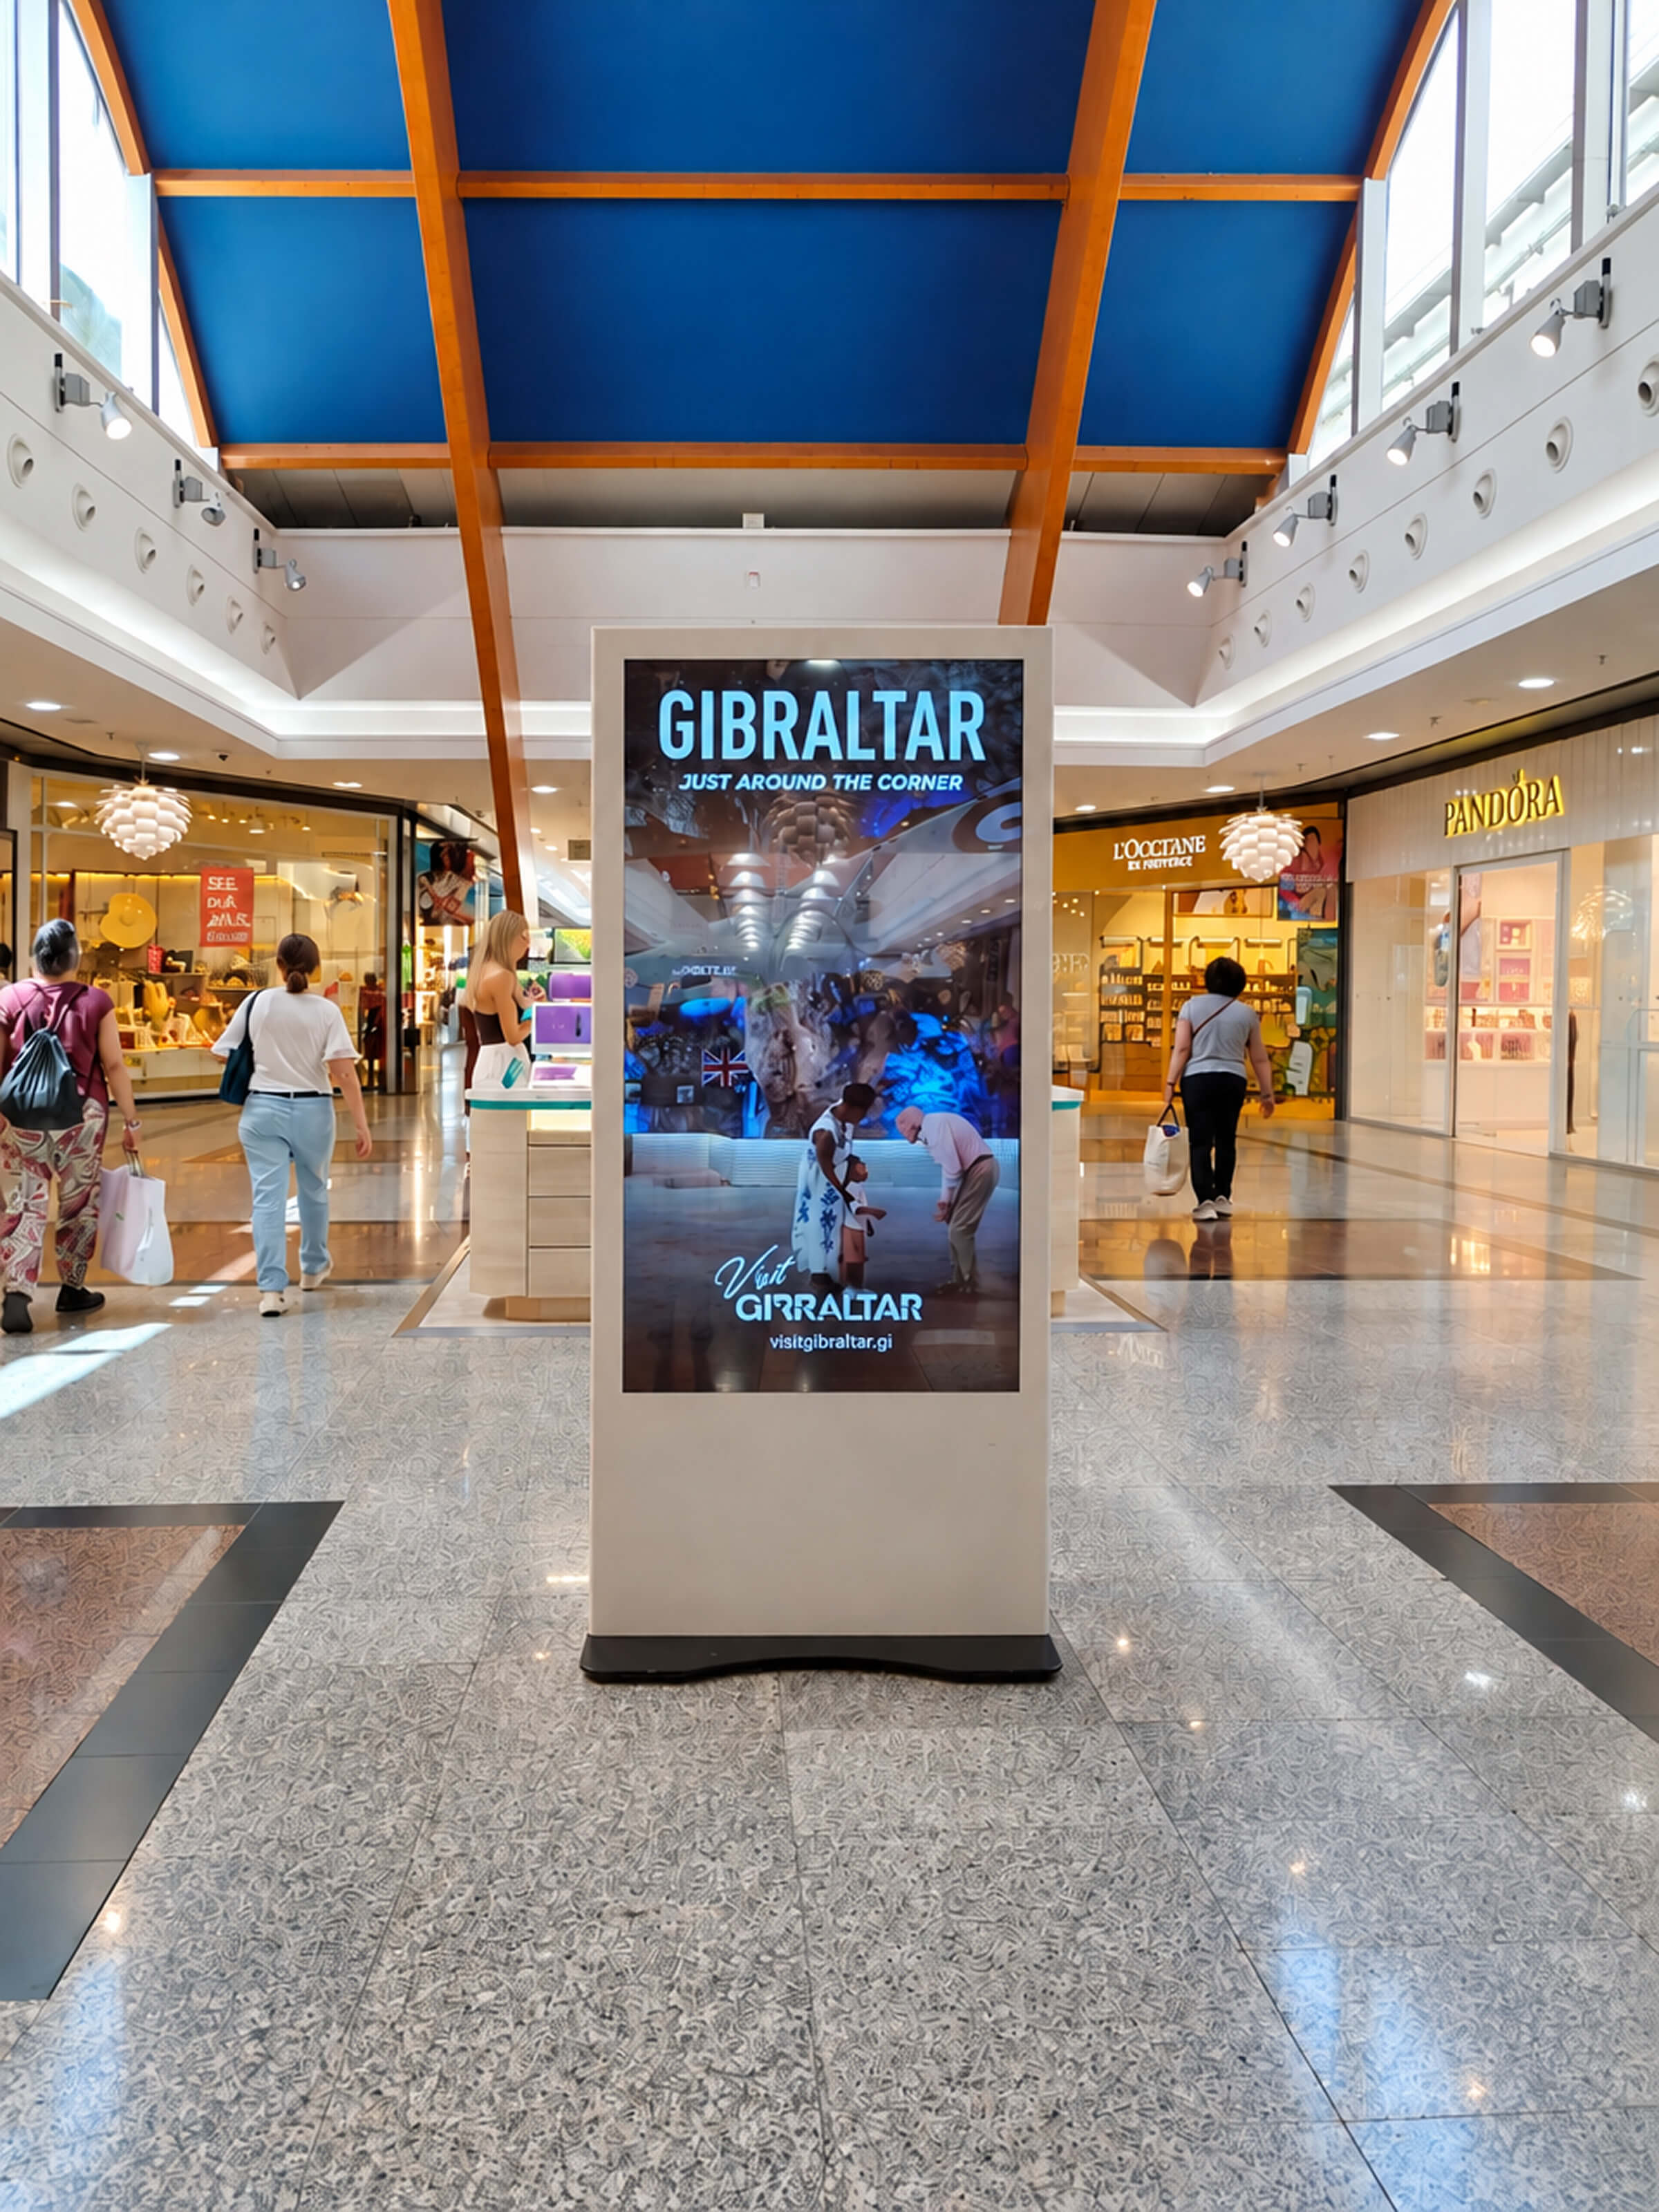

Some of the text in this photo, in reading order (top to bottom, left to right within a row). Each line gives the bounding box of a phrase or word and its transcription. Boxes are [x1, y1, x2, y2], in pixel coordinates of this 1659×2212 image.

[659, 690, 986, 761] GIBRALTAR
[678, 773, 964, 791] JUST AROUND THE CORNER
[1443, 768, 1564, 838] PANDORA
[207, 876, 238, 891] SEE
[714, 1244, 796, 1299] Visit
[769, 1333, 892, 1352] visitgibraltar.gi
